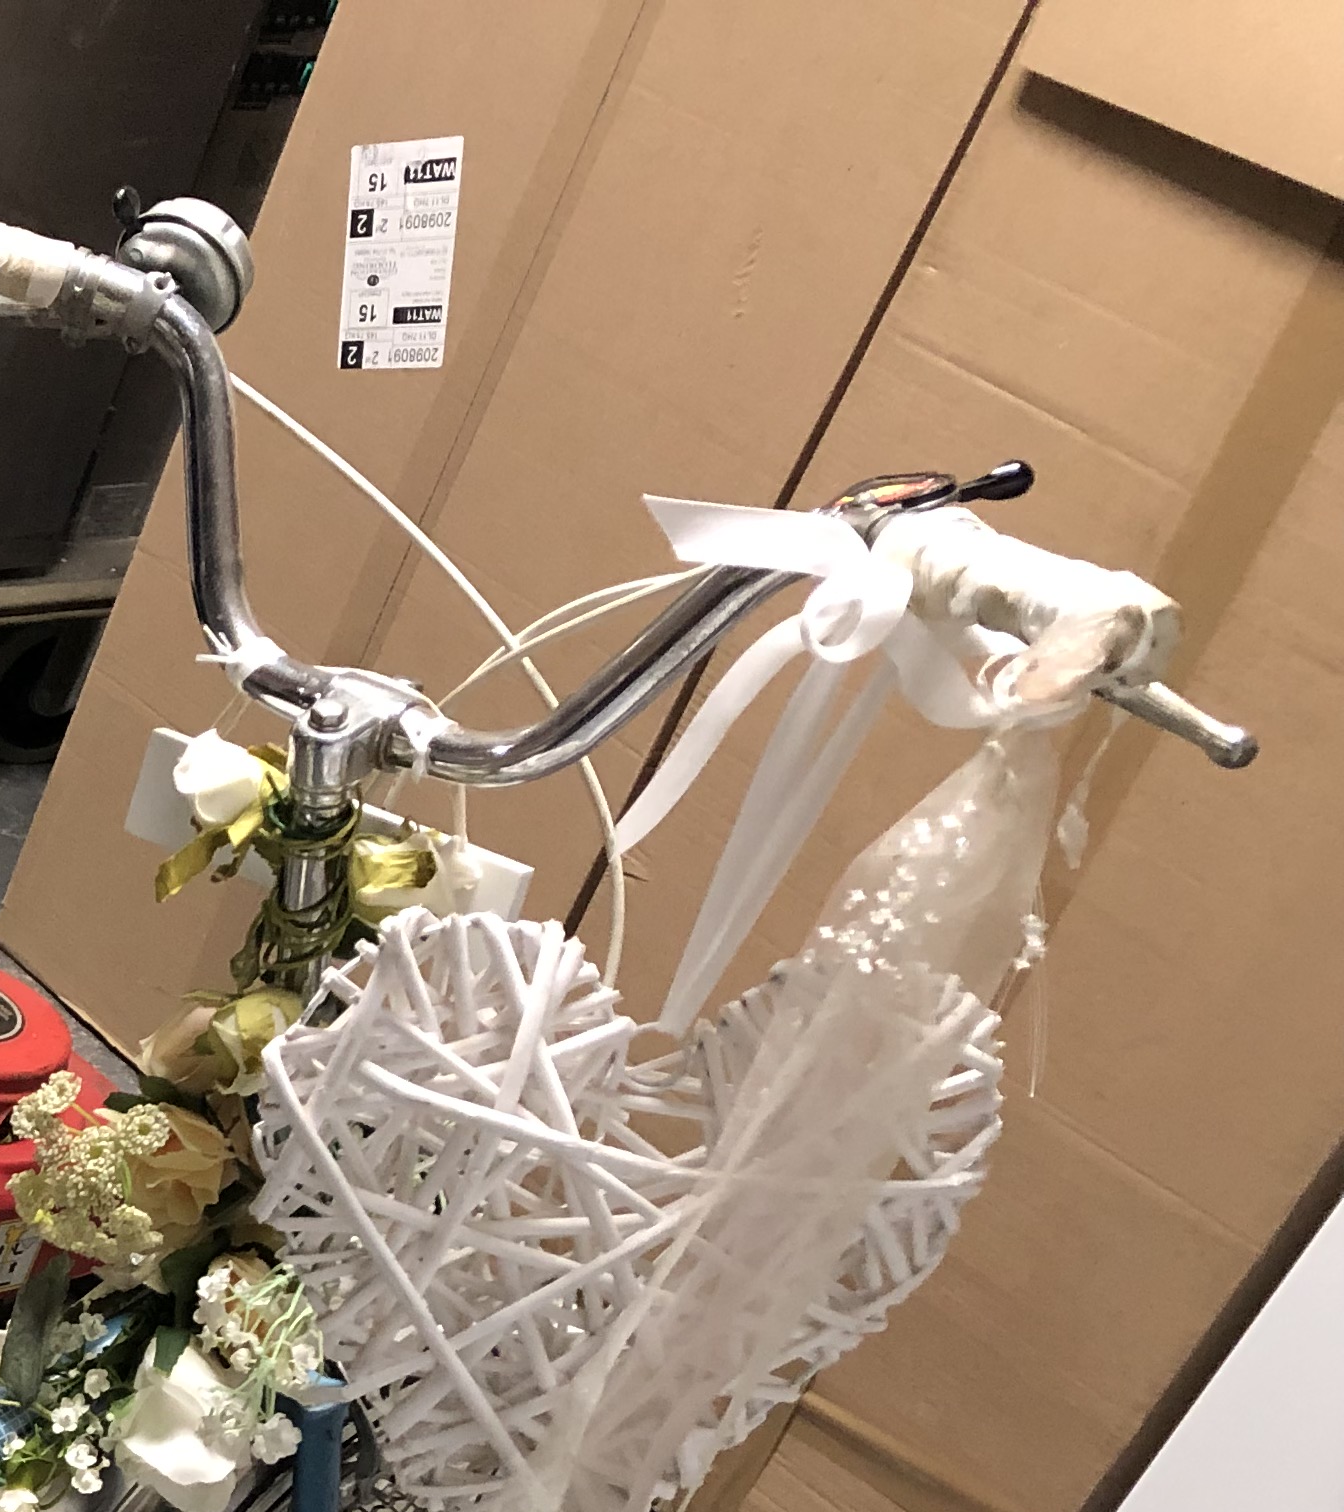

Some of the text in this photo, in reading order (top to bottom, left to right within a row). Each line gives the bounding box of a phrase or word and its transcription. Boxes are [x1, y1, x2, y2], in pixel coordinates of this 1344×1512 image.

[368, 172, 387, 192] 15
[356, 214, 368, 234] 2
[399, 211, 452, 230] 2098091
[358, 304, 377, 323] 15
[406, 307, 442, 321] WAT11
[346, 346, 358, 365] 2
[388, 347, 439, 363] 2098091
